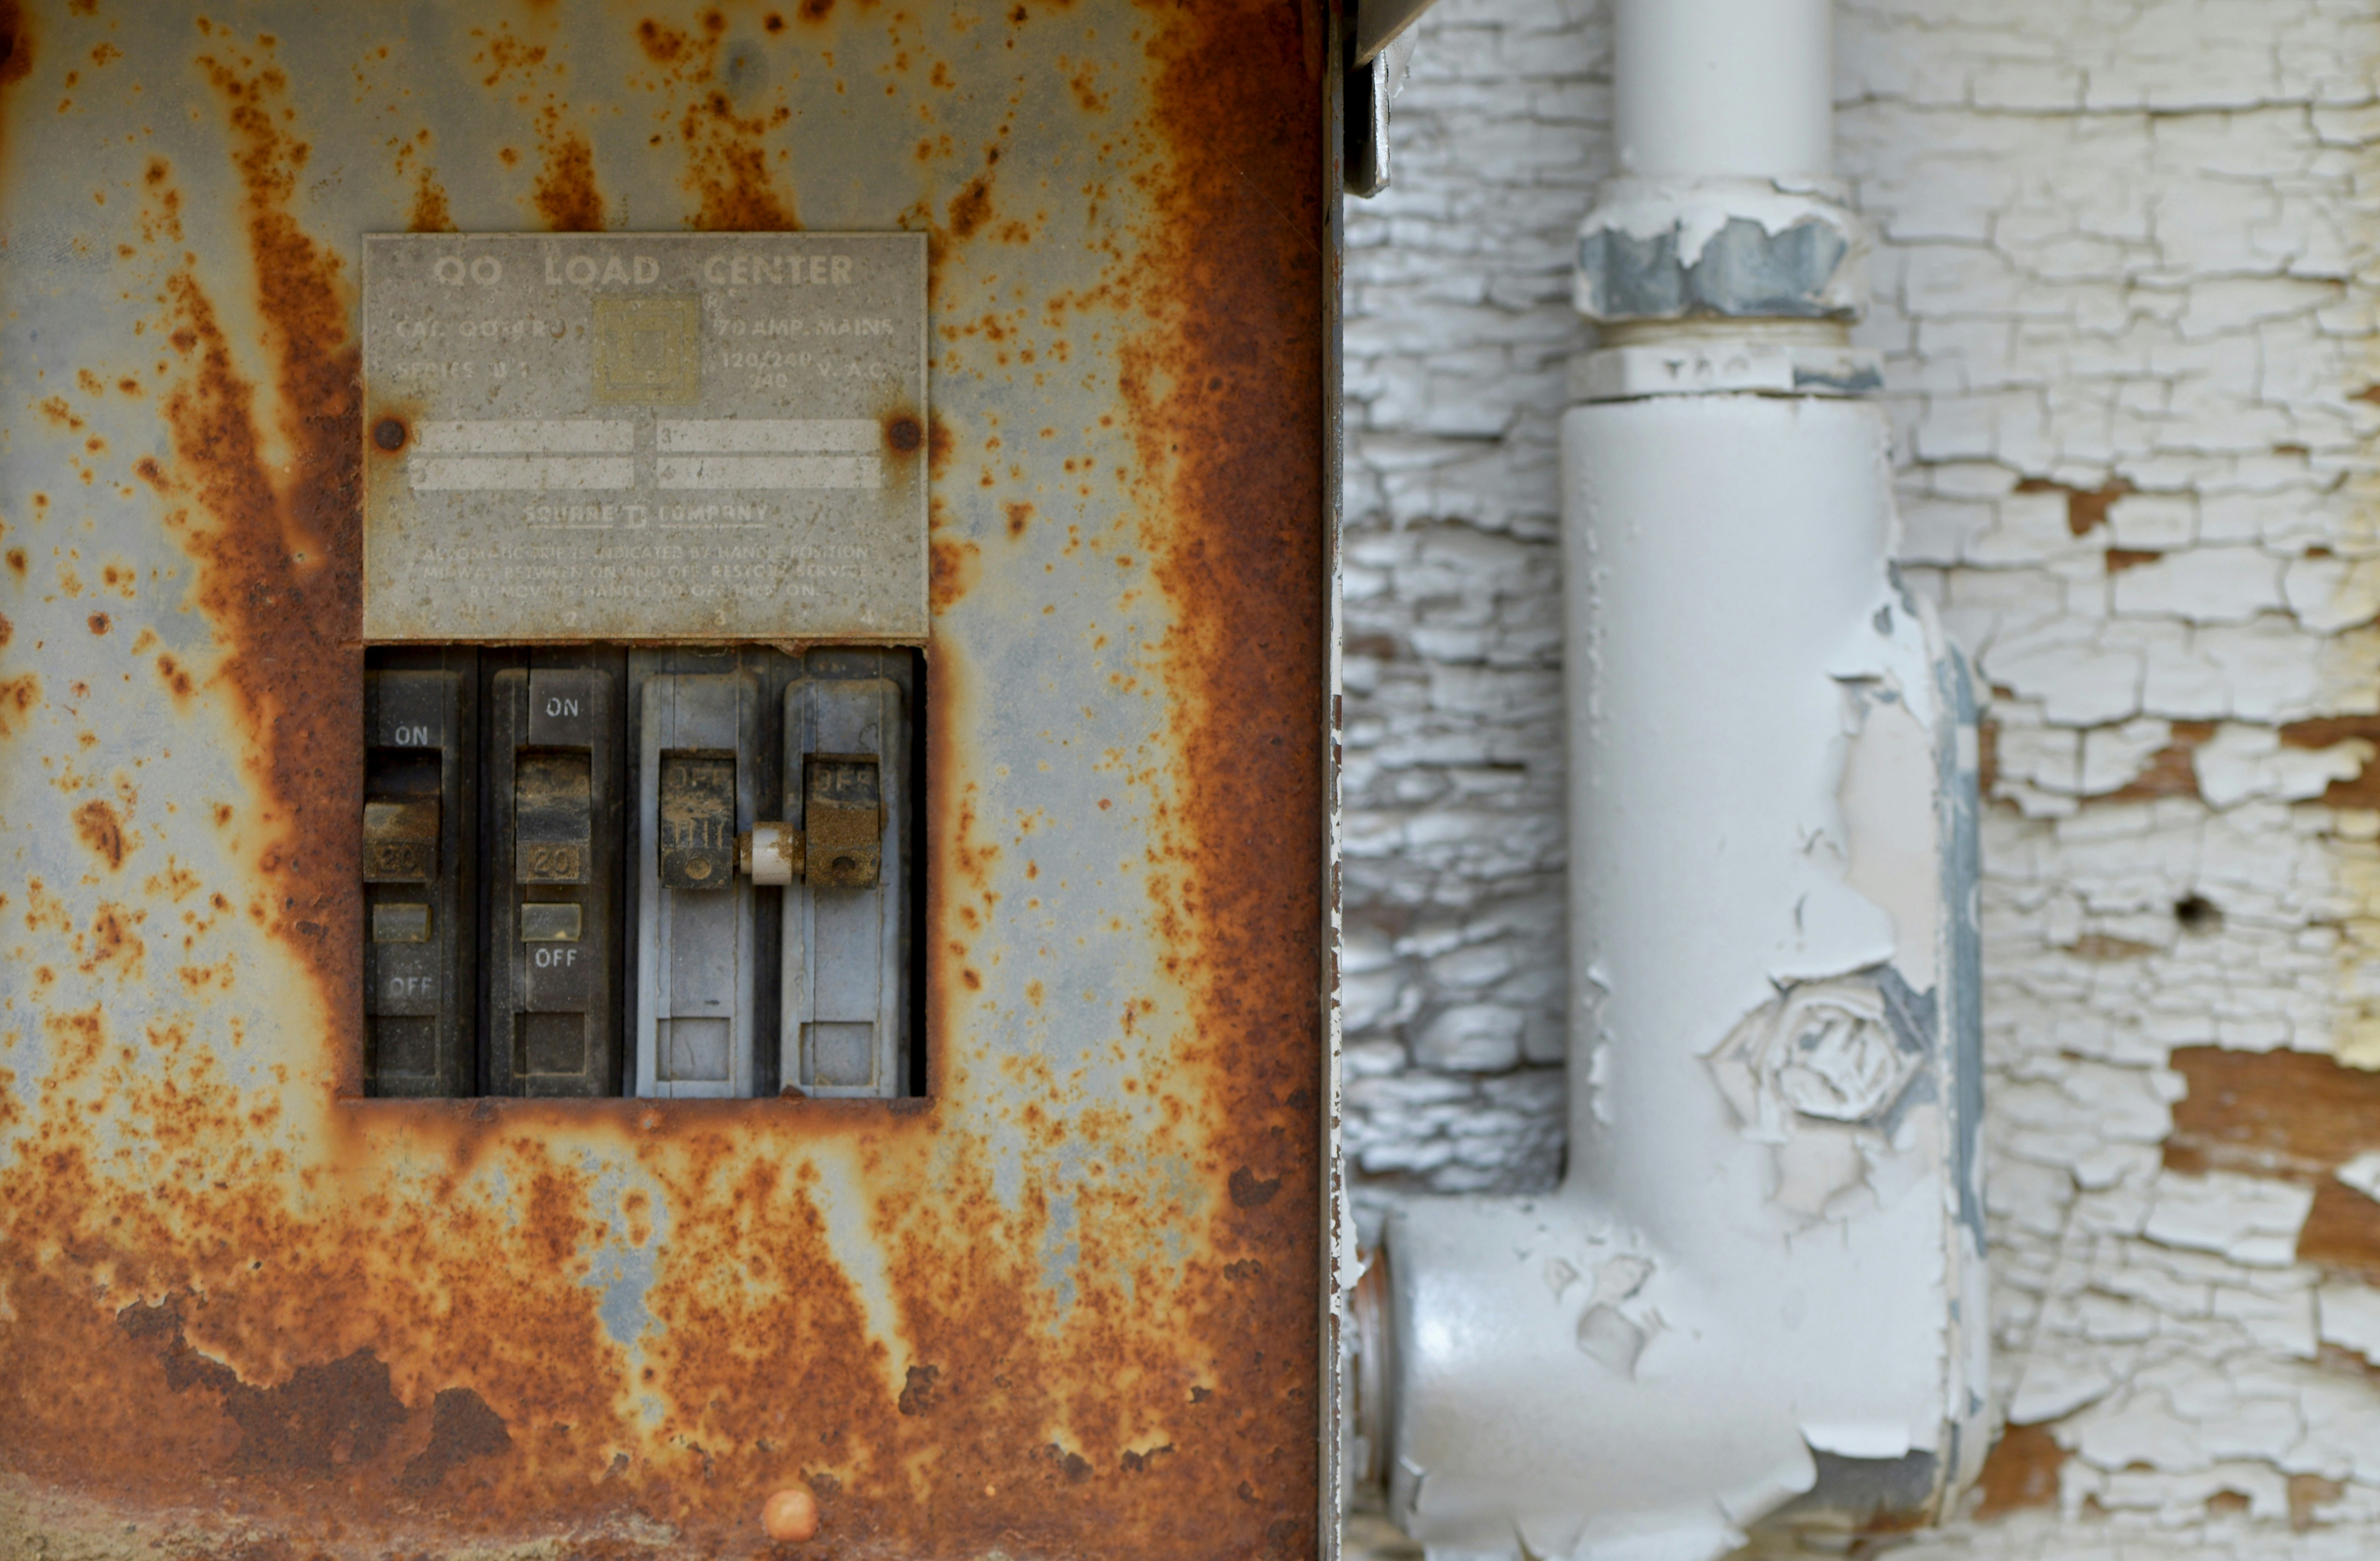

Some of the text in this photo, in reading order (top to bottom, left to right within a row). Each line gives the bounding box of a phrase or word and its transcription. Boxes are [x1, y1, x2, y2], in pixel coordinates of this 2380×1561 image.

[434, 255, 853, 286] QO LOAD CENTER
[816, 318, 894, 336] MAINS
[722, 350, 813, 370] 120/240
[661, 427, 672, 444] 3
[523, 505, 614, 522] SQUARE
[658, 505, 769, 522] COMPANY
[423, 547, 523, 560] AUOMATIC
[531, 547, 565, 559] RIP
[594, 546, 684, 559] NDICATED
[790, 545, 868, 559] POSITION
[590, 566, 616, 579] ON
[623, 565, 662, 579] AND
[711, 565, 785, 578] RESTOR
[500, 585, 574, 598] MOVG
[546, 697, 578, 717] ON
[395, 725, 428, 746] ON
[380, 842, 416, 873] 20
[534, 849, 570, 875] 20
[535, 948, 578, 968] OFF
[389, 976, 433, 998] OFF
